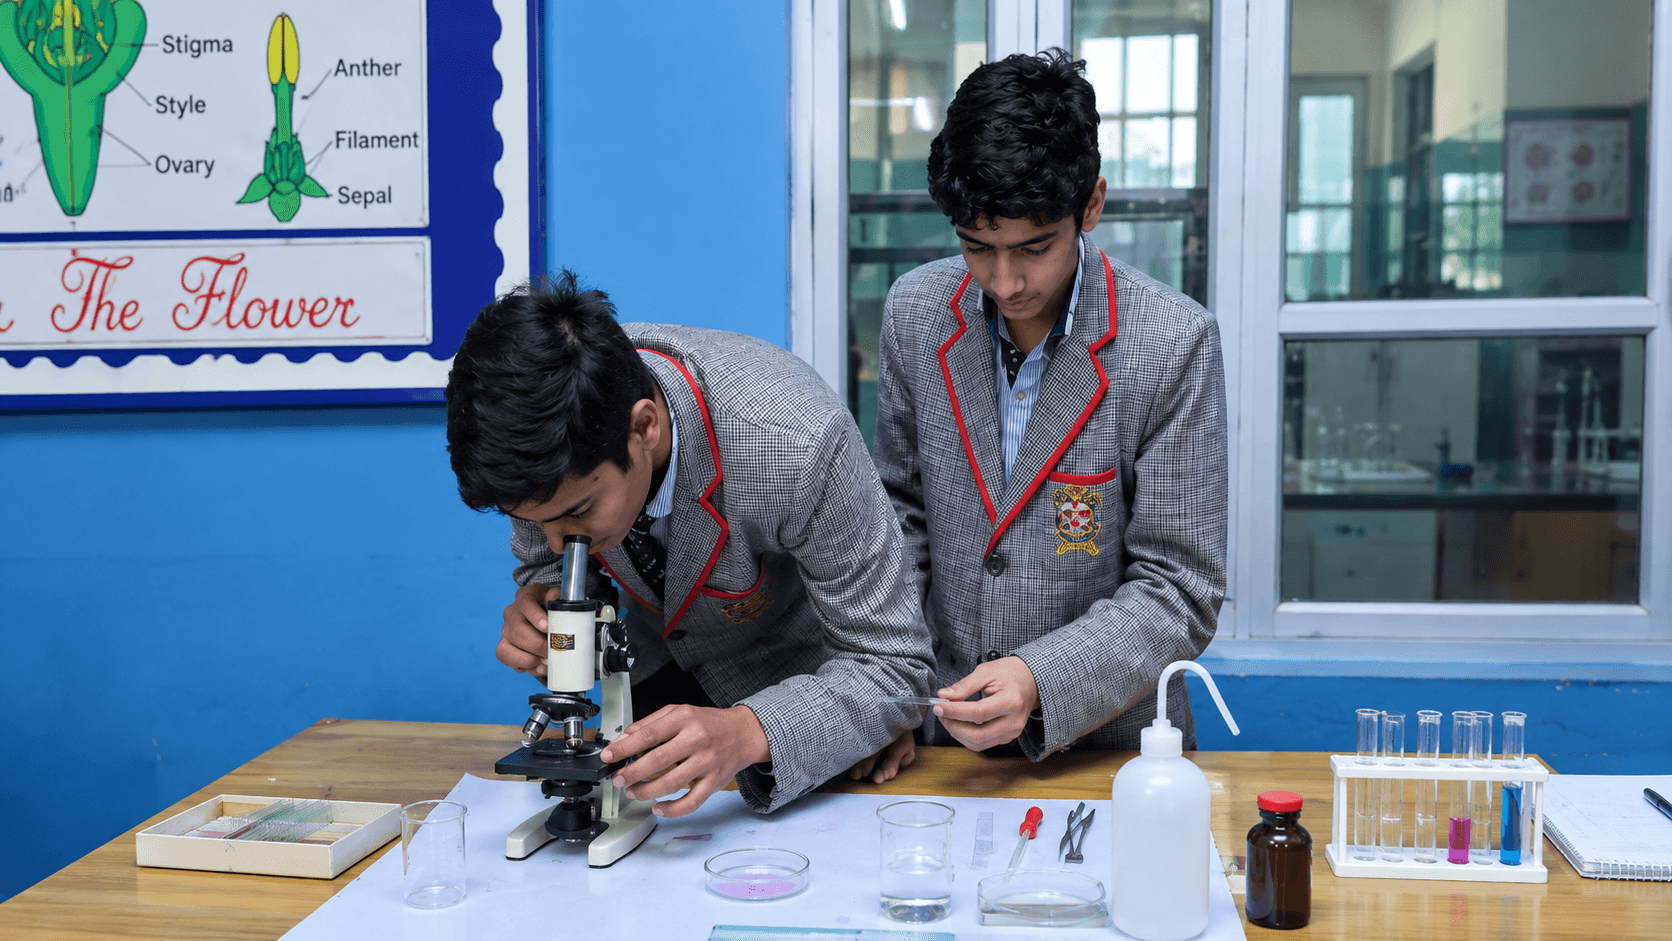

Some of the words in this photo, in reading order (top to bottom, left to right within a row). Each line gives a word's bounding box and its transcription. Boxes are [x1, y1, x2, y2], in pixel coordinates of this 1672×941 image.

[162, 35, 233, 58] Stigma
[334, 58, 402, 77] Anther
[155, 95, 206, 119] Style
[335, 130, 419, 149] Filament
[155, 155, 215, 178] Ovary
[338, 185, 392, 209] Sepal
[51, 255, 144, 333] The
[172, 252, 360, 331] Flower
